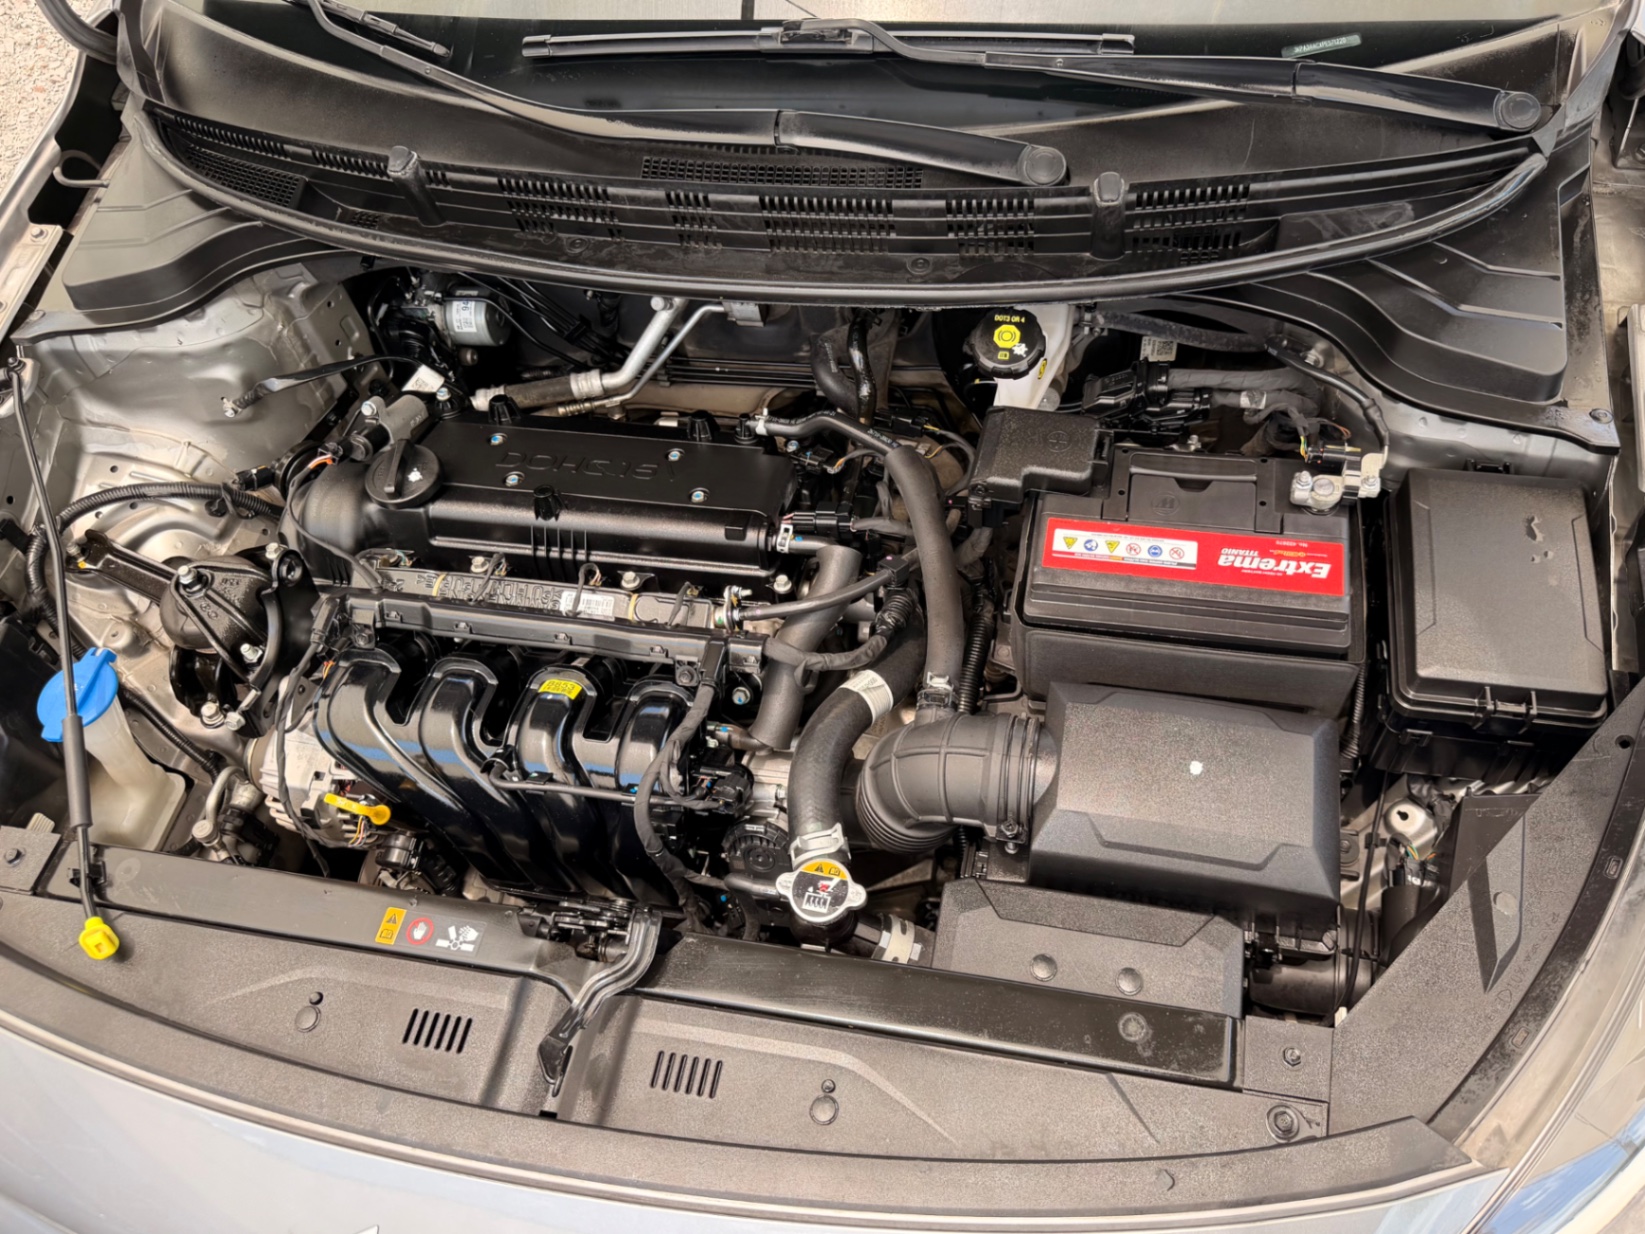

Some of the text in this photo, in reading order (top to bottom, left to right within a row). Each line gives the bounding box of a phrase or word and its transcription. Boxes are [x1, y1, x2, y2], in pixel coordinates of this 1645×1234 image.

[495, 452, 611, 476] DOHC
[1221, 548, 1259, 556] TITANIO
[1217, 555, 1331, 578] Extrema
